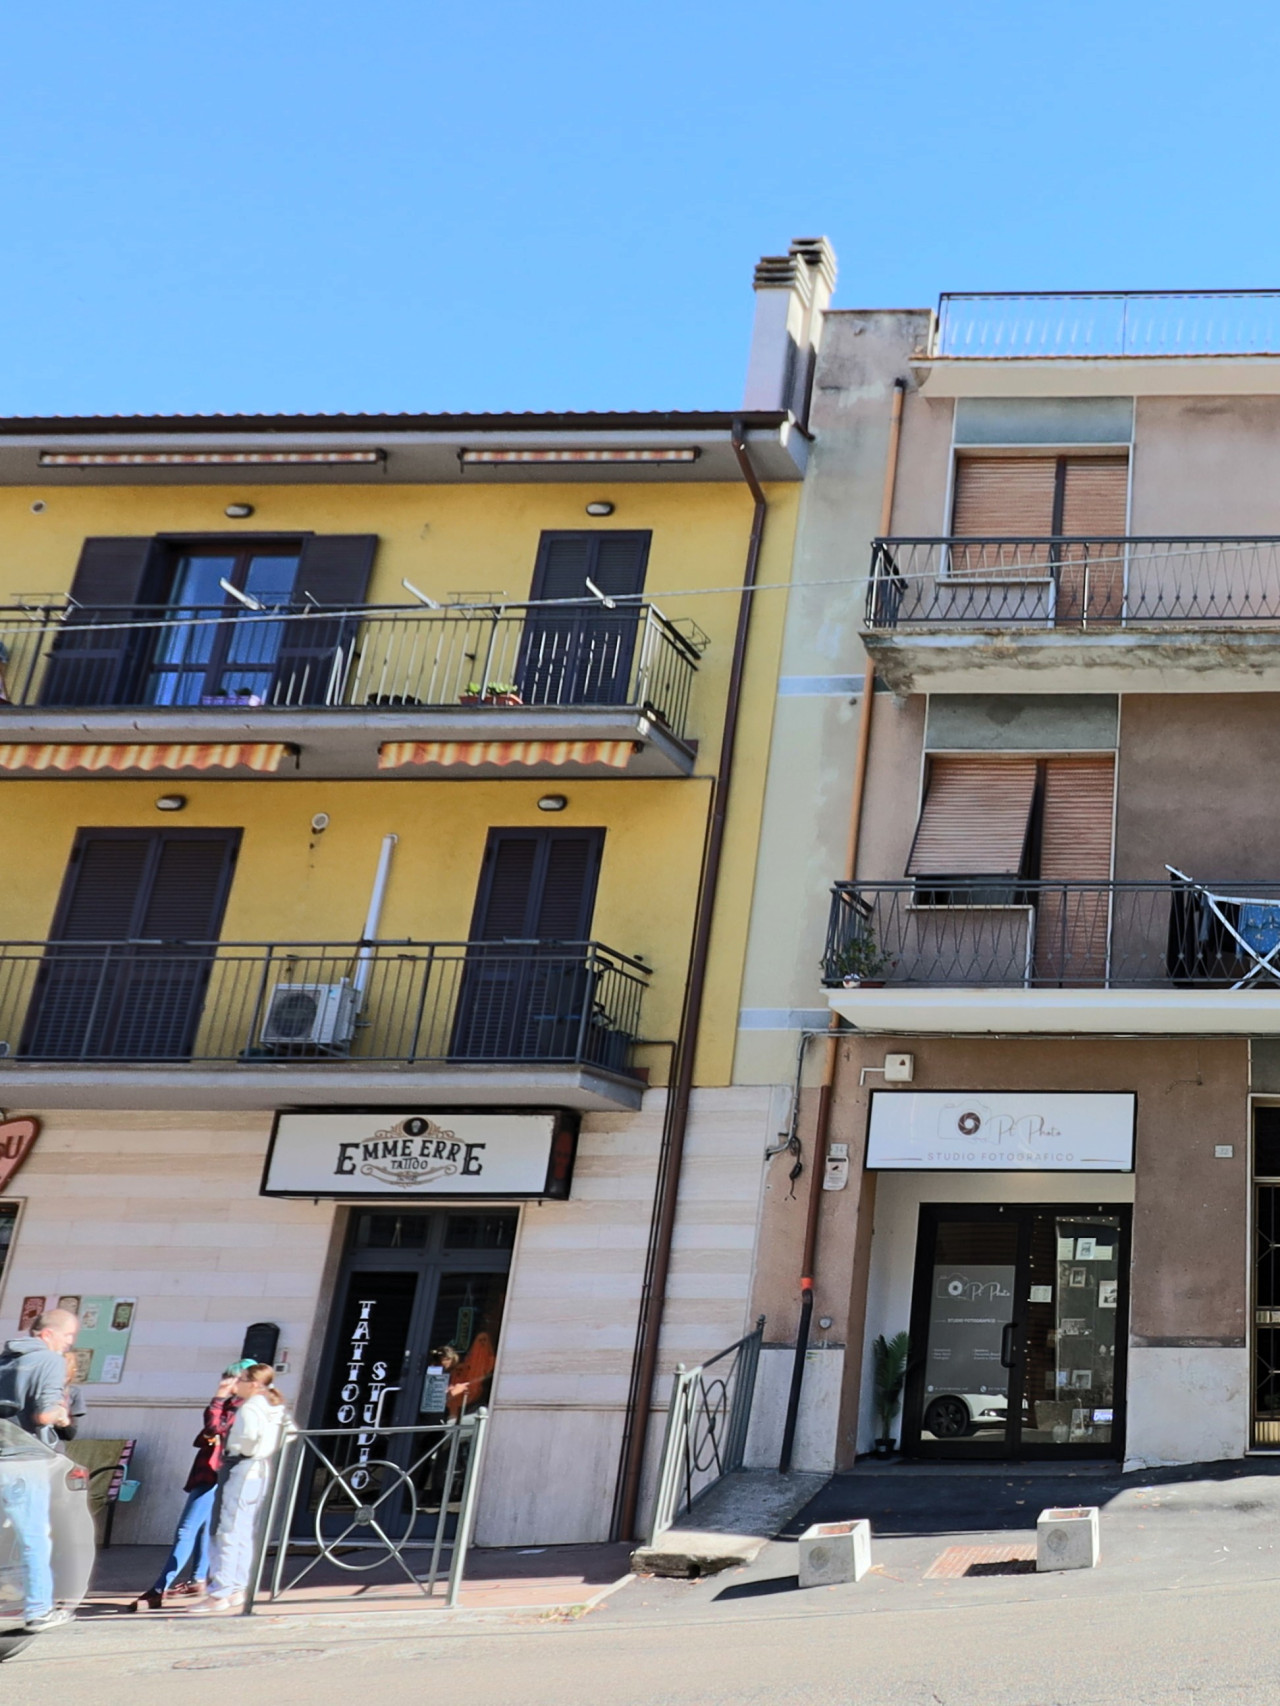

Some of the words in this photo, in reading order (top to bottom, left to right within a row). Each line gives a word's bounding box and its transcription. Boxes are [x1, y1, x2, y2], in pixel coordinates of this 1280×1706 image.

[1016, 1114, 1062, 1144] Photo
[333, 1139, 414, 1175] EMME
[418, 1139, 486, 1176] ERRE
[391, 1157, 428, 1170] TATTOO
[927, 1152, 976, 1162] STUDIO
[981, 1152, 1074, 1163] FOTOGRAFICO
[337, 1300, 377, 1424] TATTOO
[351, 1361, 388, 1490] STUDIO
